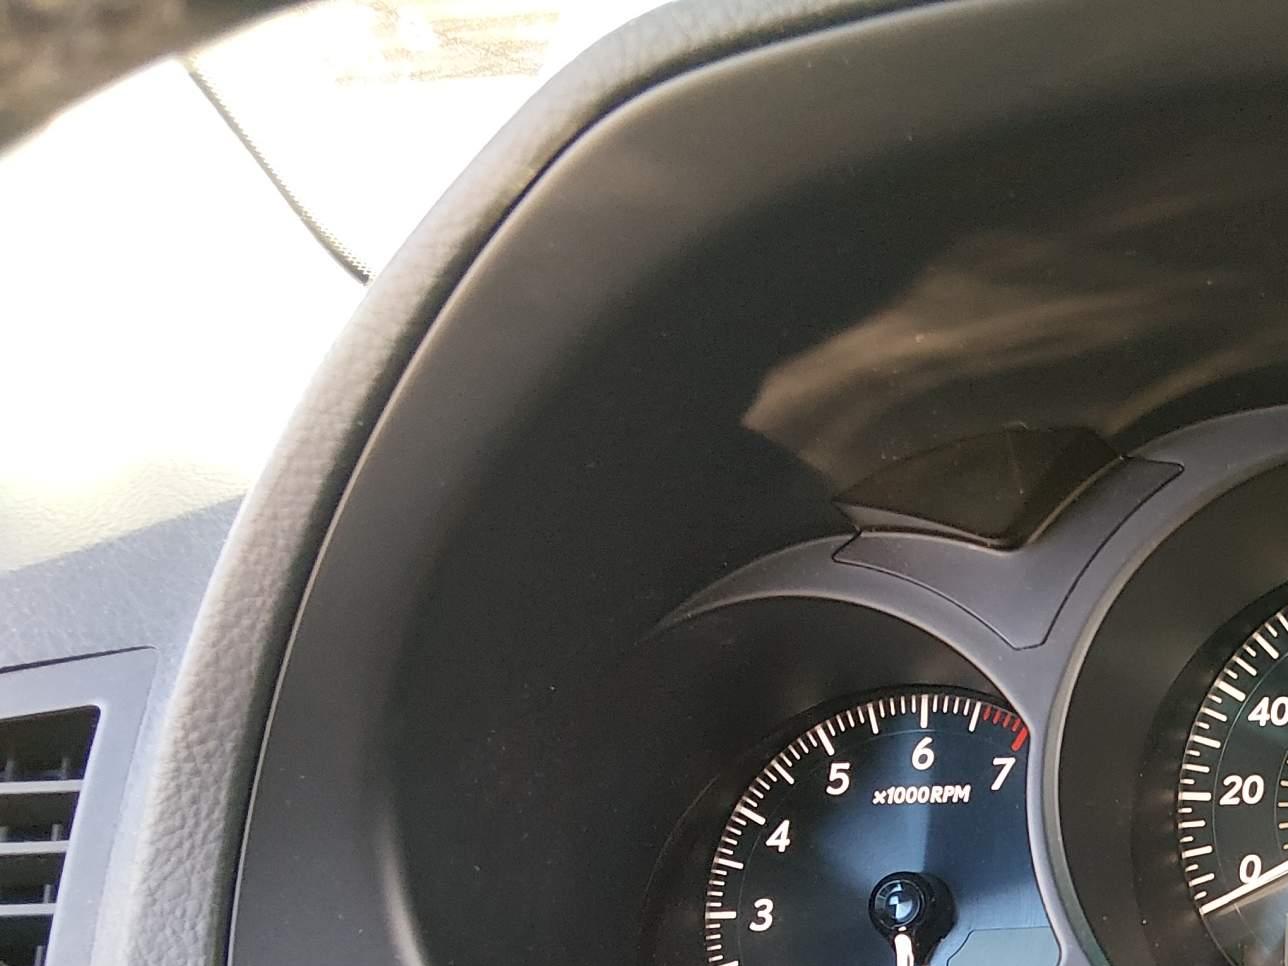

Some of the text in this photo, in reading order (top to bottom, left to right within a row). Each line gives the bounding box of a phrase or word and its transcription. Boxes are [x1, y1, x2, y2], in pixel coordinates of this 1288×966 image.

[911, 736, 935, 771] 6
[826, 762, 851, 796] 5
[991, 757, 1016, 791] 7
[1219, 774, 1265, 806] 20
[766, 820, 791, 853] 4
[1239, 854, 1264, 886] 0
[749, 898, 774, 932] 3
